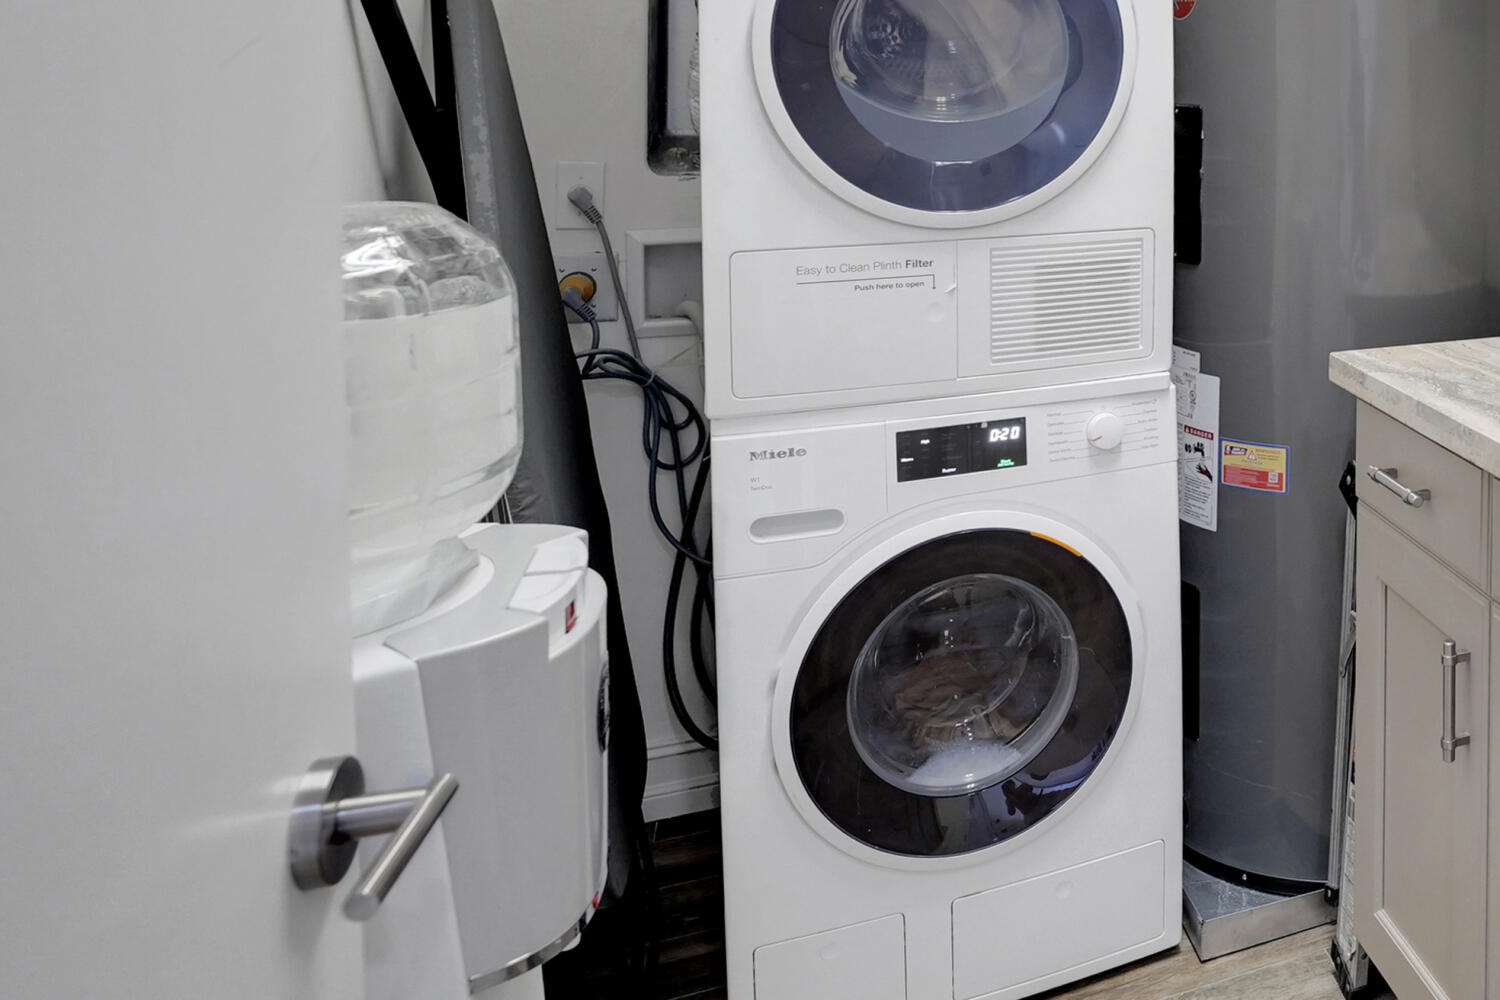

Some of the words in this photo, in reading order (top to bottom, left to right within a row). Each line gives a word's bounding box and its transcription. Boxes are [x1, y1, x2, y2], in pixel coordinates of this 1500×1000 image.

[796, 265, 823, 277] Easy
[825, 264, 837, 274] to
[839, 262, 871, 273] Clean
[873, 260, 902, 271] Plinth
[905, 258, 934, 269] Filter
[854, 284, 875, 292] Push
[876, 282, 894, 290] here
[905, 280, 925, 290] open
[989, 426, 1021, 443] 0:20
[749, 447, 808, 461] Miele
